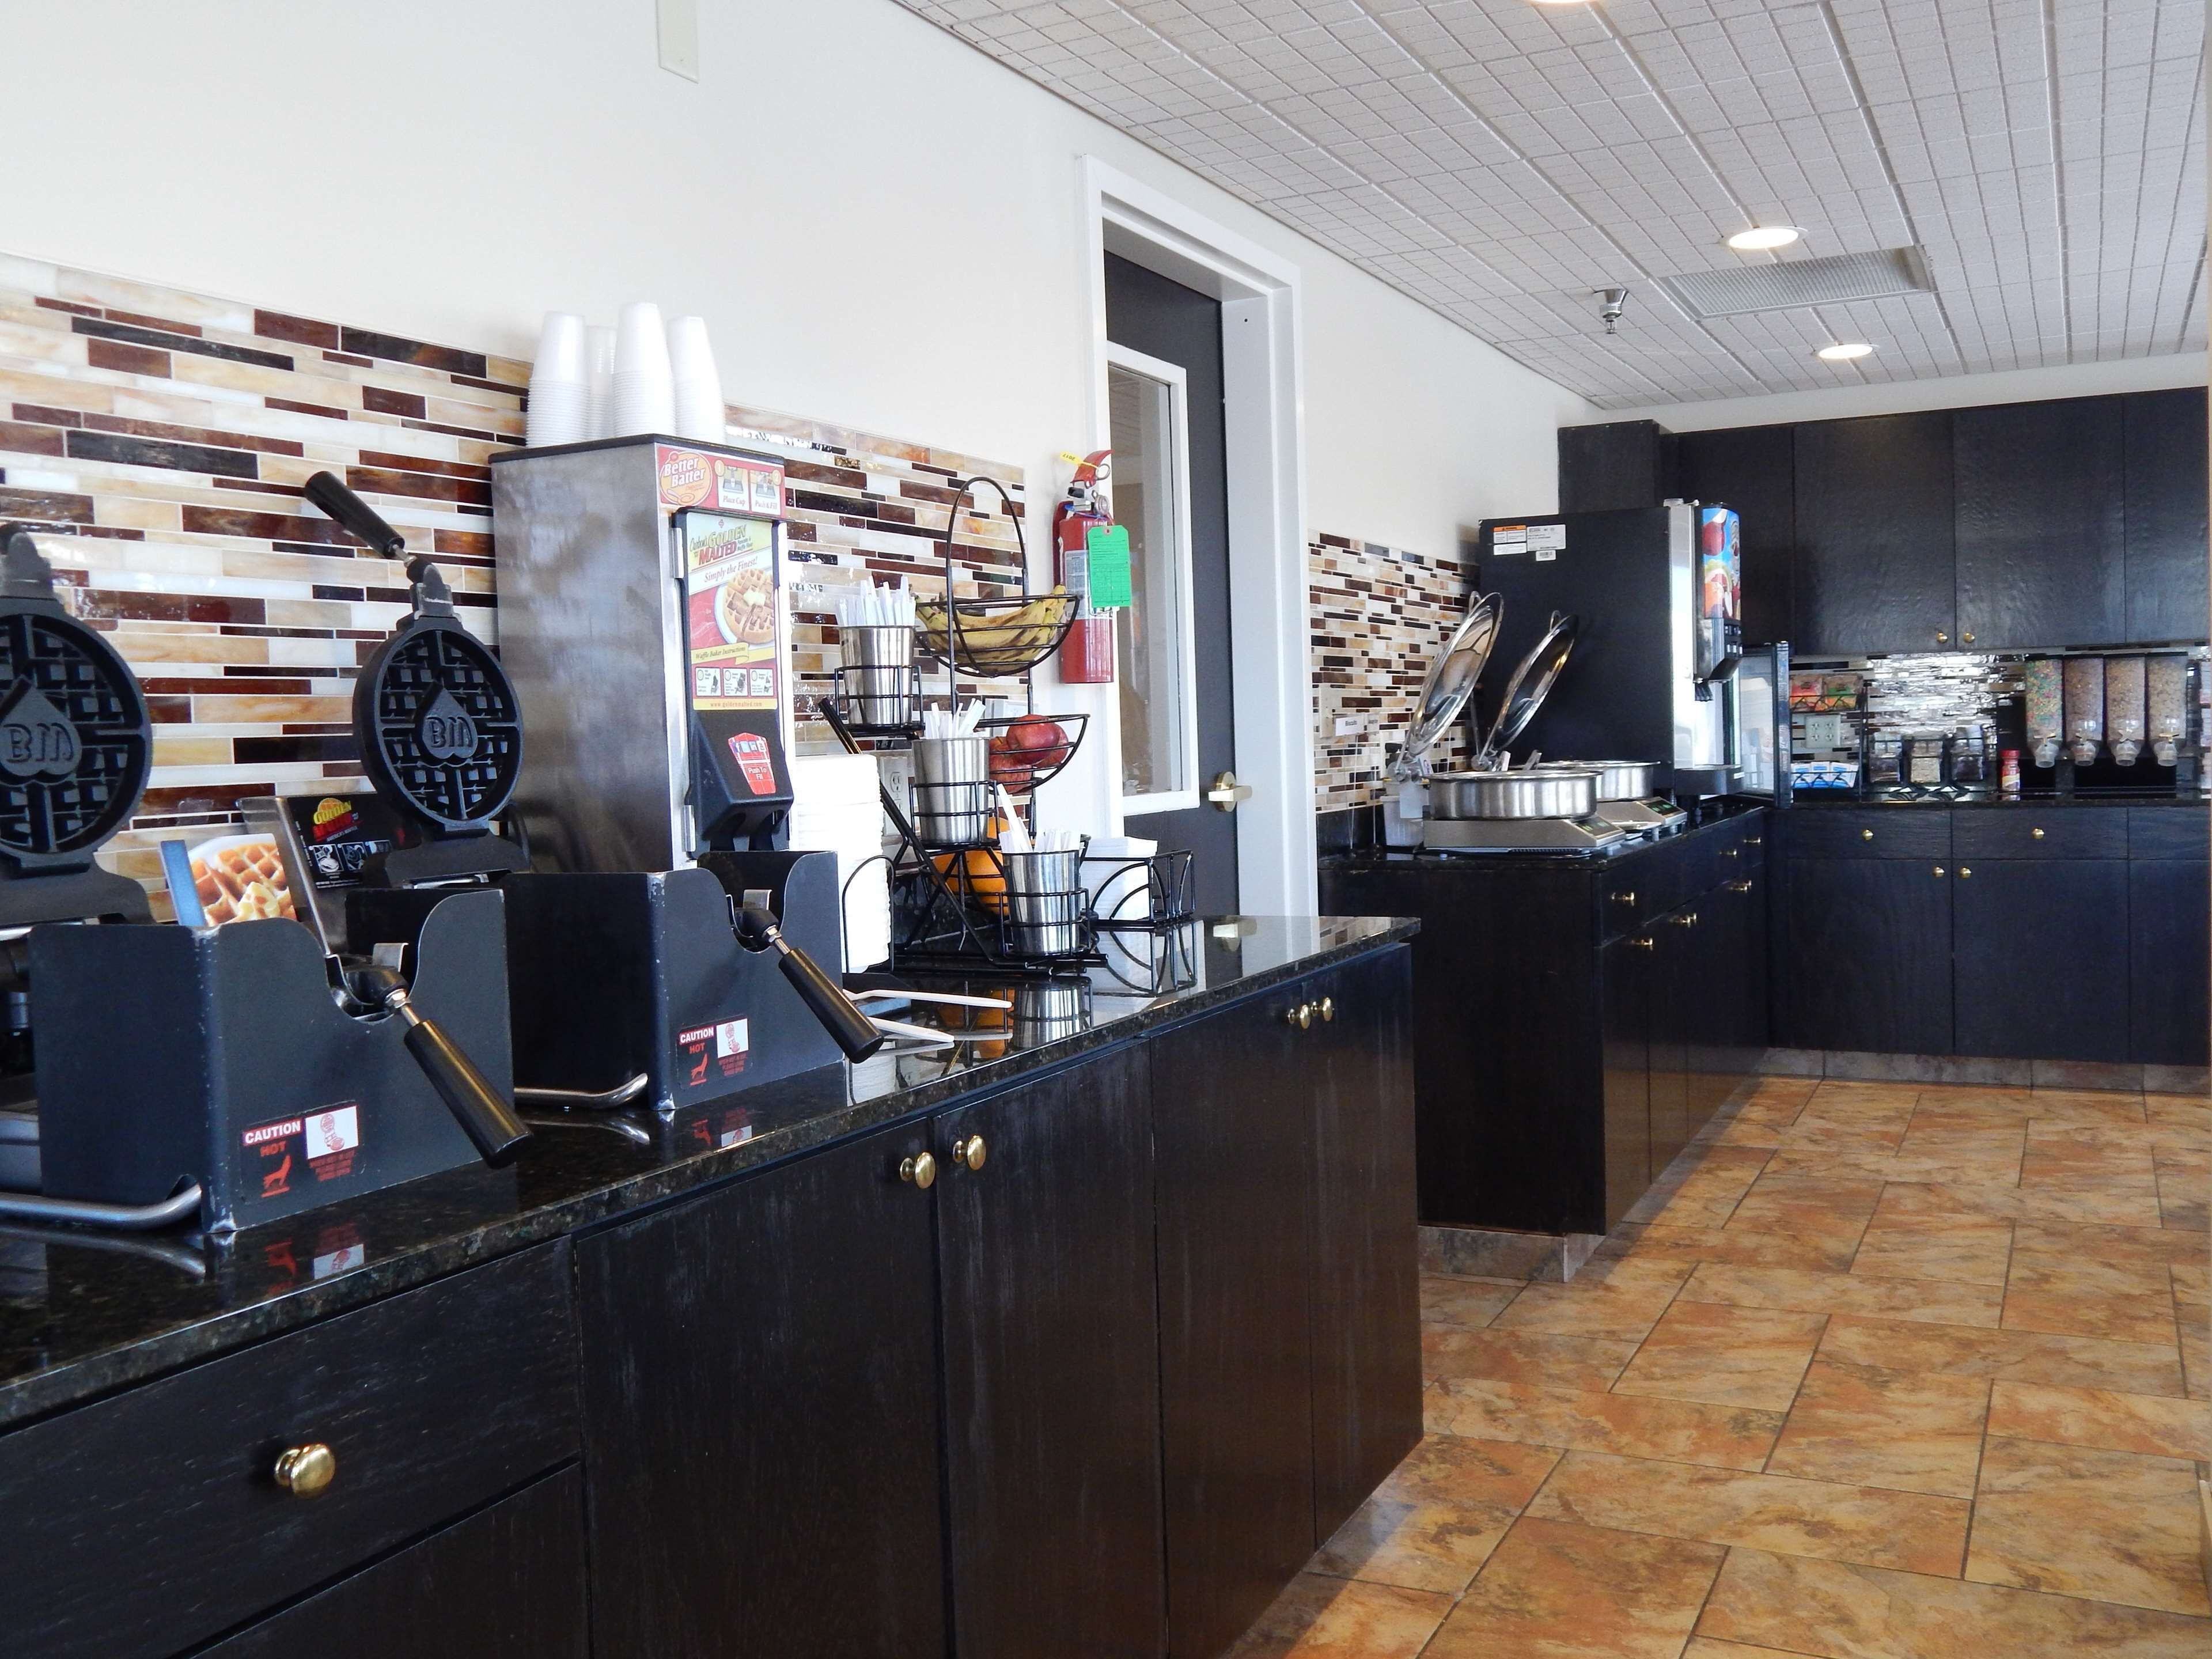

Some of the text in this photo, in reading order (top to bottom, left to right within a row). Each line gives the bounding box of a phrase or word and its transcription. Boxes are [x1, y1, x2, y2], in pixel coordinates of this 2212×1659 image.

[664, 457, 699, 477] Better
[671, 468, 706, 488] Batter
[723, 495, 745, 506] Place Cup
[755, 499, 765, 507] Push
[708, 524, 747, 548] GOLDEN
[699, 540, 737, 566] MALTED
[704, 556, 758, 582] Simply the Finest!
[680, 1027, 714, 1043] CAUTION
[689, 1042, 706, 1054] HOT
[245, 1120, 301, 1144] CAUTION
[260, 1140, 286, 1157] HOT
